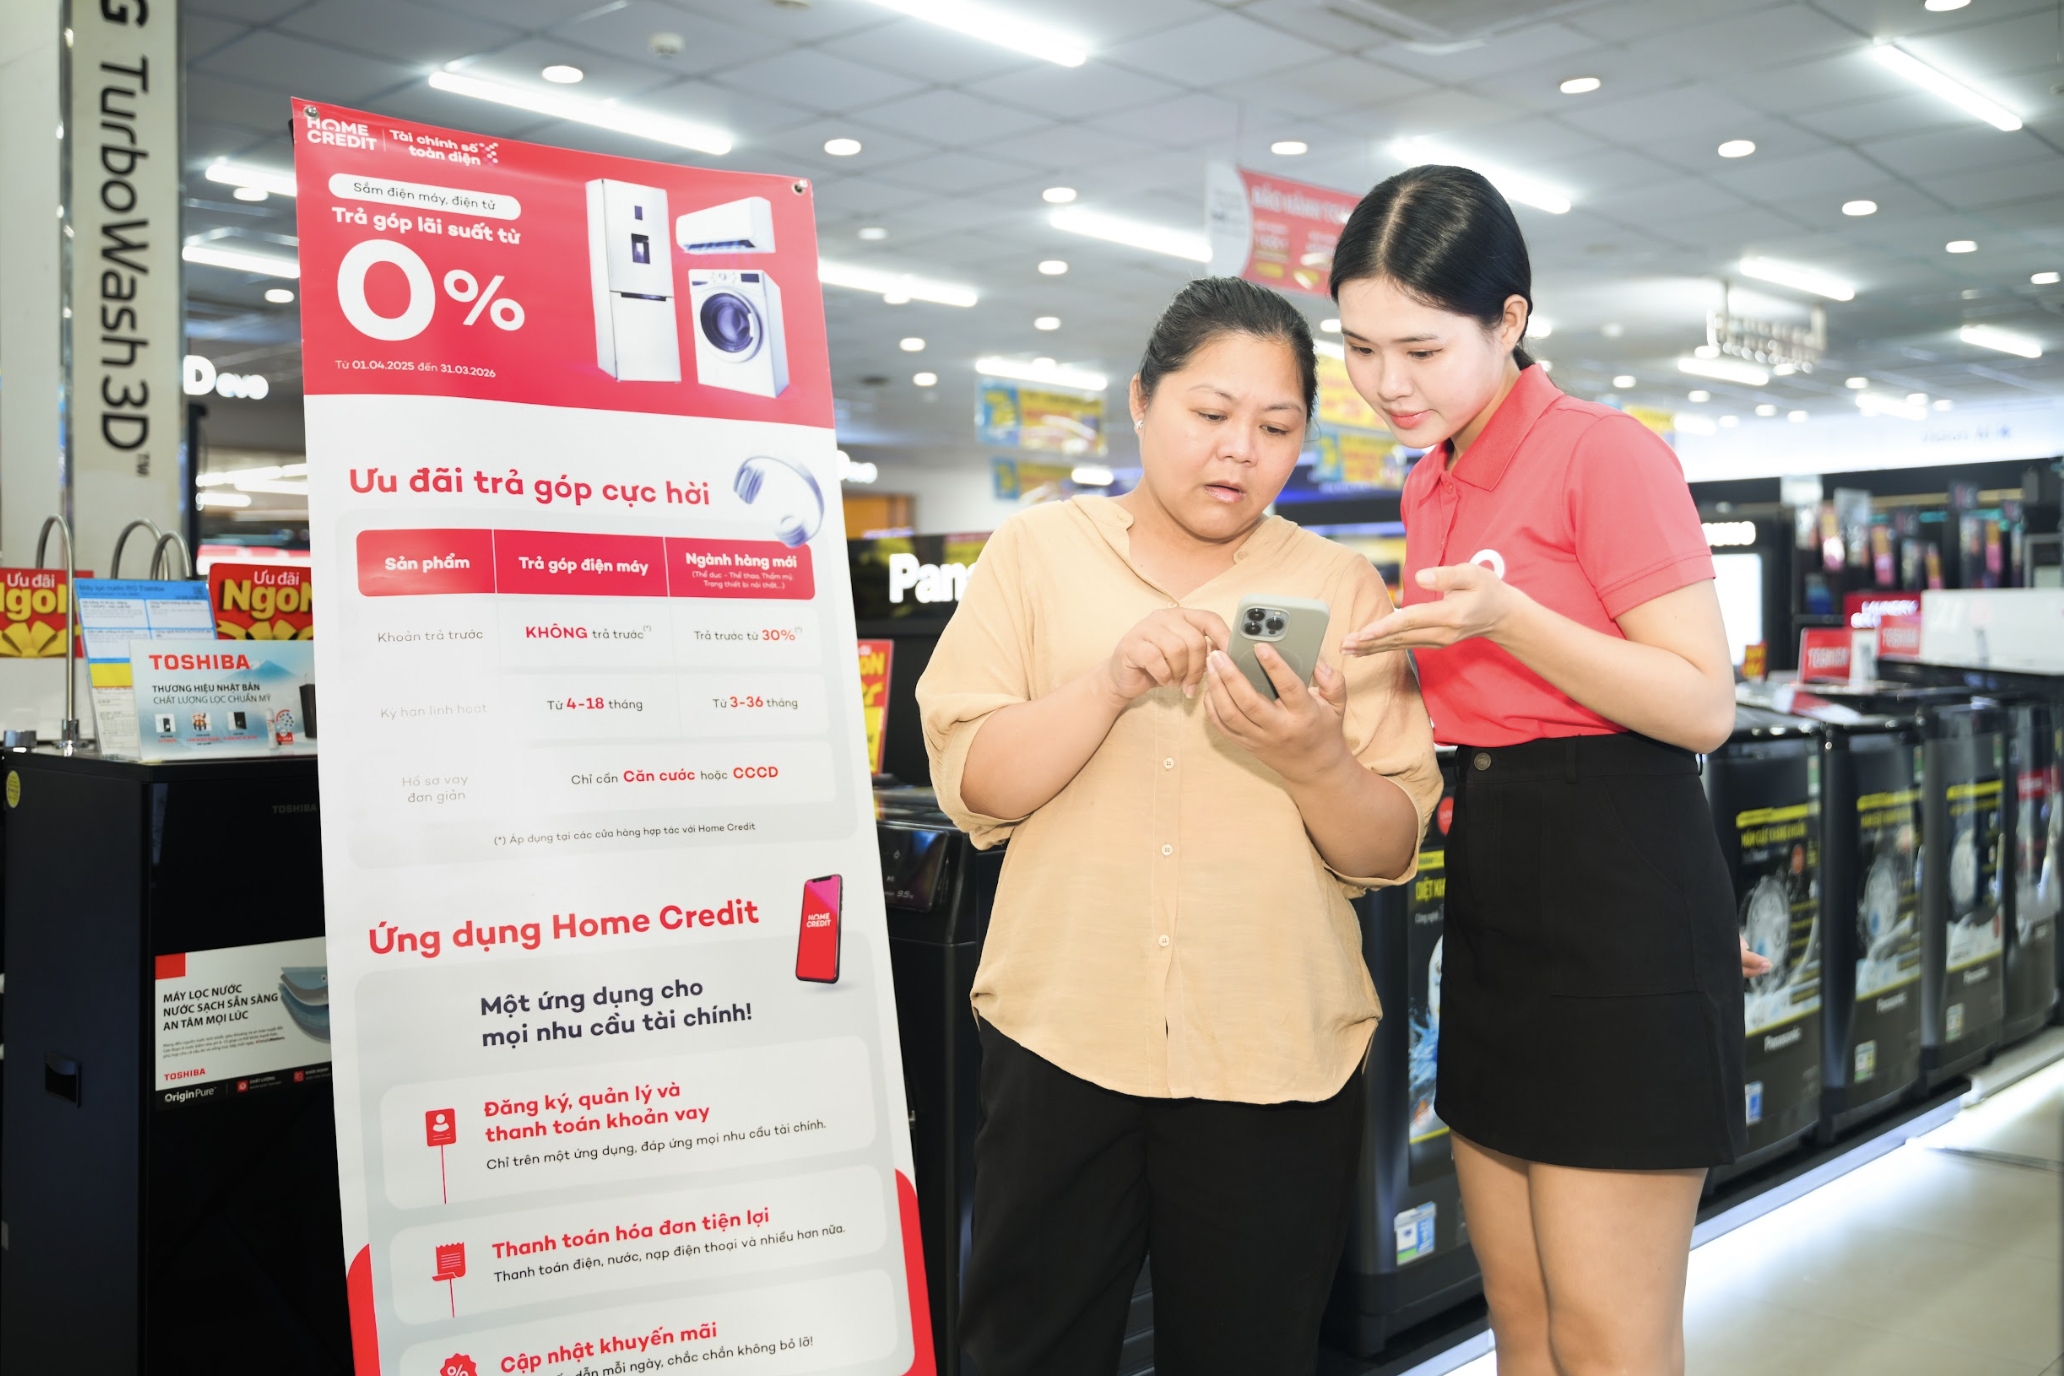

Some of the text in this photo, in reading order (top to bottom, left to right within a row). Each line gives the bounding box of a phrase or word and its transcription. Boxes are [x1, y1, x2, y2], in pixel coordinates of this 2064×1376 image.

[307, 117, 369, 136] HOME
[307, 129, 377, 150] CREDIT
[389, 129, 479, 153] Tài chính số
[408, 145, 481, 166] toàn diện
[353, 182, 496, 211] Sắm điện máy, điện tử
[331, 206, 521, 245] Trả góp lãi suất từ
[335, 360, 496, 378] Từ 01.04.2025 đến 31.03.2026
[349, 467, 710, 508] Ưu đãi trả góp cực hời
[385, 553, 470, 573] Sản phẩm
[518, 556, 649, 576] Trả góp điện máy
[685, 552, 797, 570] Ngành hàng mới
[7, 571, 55, 588] Ưu đãi
[254, 569, 299, 585] Ưu đãi
[525, 623, 588, 639] KHÔNG
[592, 628, 610, 639] trả
[694, 629, 711, 640] Trả
[714, 631, 743, 641] trước
[747, 631, 759, 641] từ
[149, 654, 251, 670] TOSHIBA
[152, 682, 260, 694] THƯƠNG HIỆU NHẬT BẢN
[153, 694, 175, 704] CHẤT
[178, 695, 212, 705] LƯỢNG
[212, 696, 226, 704] LỌC
[228, 693, 257, 703] CHUẨN
[547, 697, 643, 712] Từ 4-18 tháng
[712, 696, 798, 710] Từ 3-36 tháng
[571, 765, 779, 785] Chỉ cần Căn cước hoặc CCCD
[509, 834, 524, 845] Áp
[527, 833, 554, 845] dụng
[556, 832, 571, 842] tại
[573, 831, 592, 840] các
[595, 828, 614, 839] cửa
[616, 827, 641, 839] hàng
[643, 826, 662, 838] hợp
[663, 825, 680, 834] tác
[682, 824, 696, 833] với
[698, 824, 725, 833] Home
[726, 822, 756, 832] Credit
[806, 919, 832, 928] CREDIT
[807, 912, 831, 921] HOME
[369, 898, 760, 959] Ứng dụng Home Credit
[163, 984, 243, 1003] MÁY LỌC NƯỚC
[480, 979, 703, 1019] Một ứng dụng cho
[163, 991, 279, 1017] NƯỚC SẠCH SẴN SÀNG
[163, 1010, 249, 1031] AN TÂM MỌI LÚC
[482, 1002, 752, 1049] mọi nhu cầu tài chính!
[164, 1068, 206, 1081] TOSHIBA
[484, 1081, 681, 1117] Đăng ký, quản lý và
[485, 1107, 710, 1143] thanh toán khoản vay
[492, 1206, 769, 1259] Thanh toán hóa đơn tiện lợi
[500, 1321, 717, 1373] Cập nhật khuyến mãi
